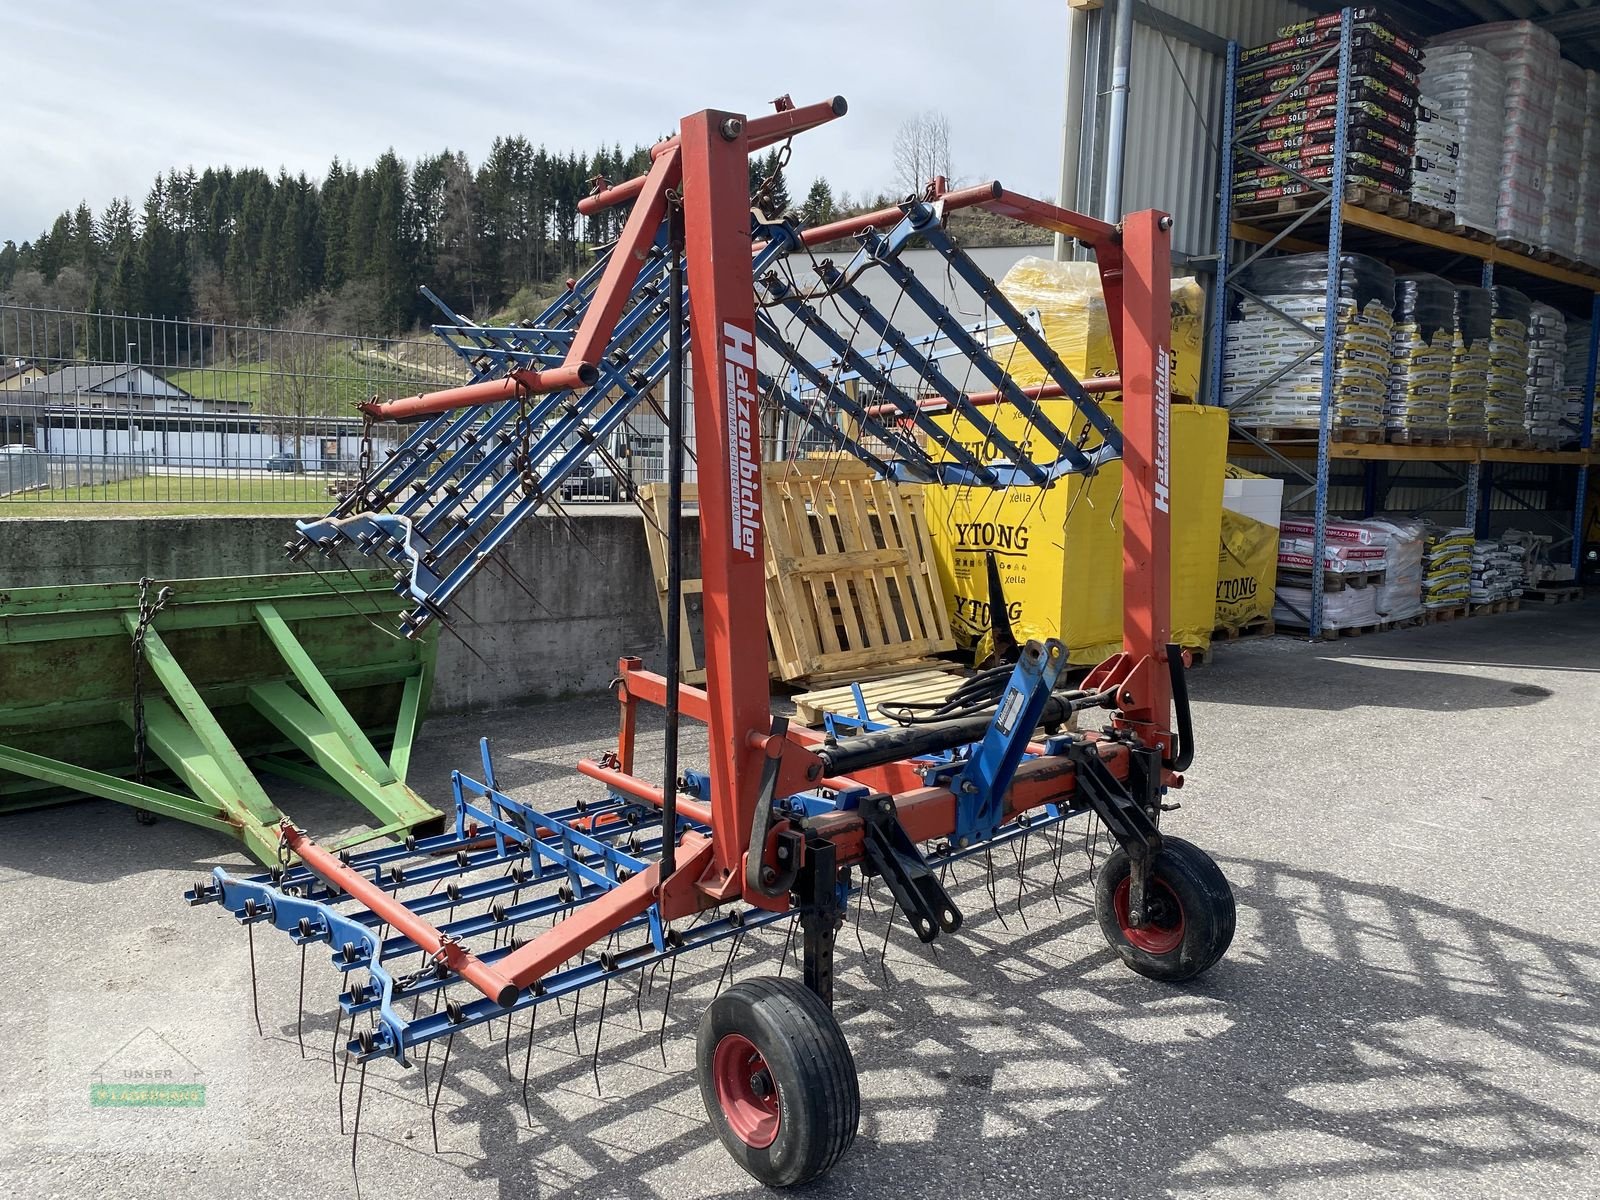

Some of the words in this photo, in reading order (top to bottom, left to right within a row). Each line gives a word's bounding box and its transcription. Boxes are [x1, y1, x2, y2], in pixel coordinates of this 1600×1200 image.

[1296, 36, 1305, 45] 50
[1291, 64, 1300, 72] 50
[1288, 114, 1297, 122] 50
[1284, 140, 1292, 148] 50
[1282, 187, 1291, 195] 50
[1154, 344, 1169, 514] Hatzenbichler
[723, 321, 760, 559] Hatzenbichler
[728, 380, 740, 521] LANDMASCHINENBAU
[1009, 493, 1032, 504] xella
[955, 522, 1029, 550] YTONG
[1004, 575, 1026, 585] xella
[1215, 576, 1258, 600] YTONG
[953, 594, 1023, 628] YTOG
